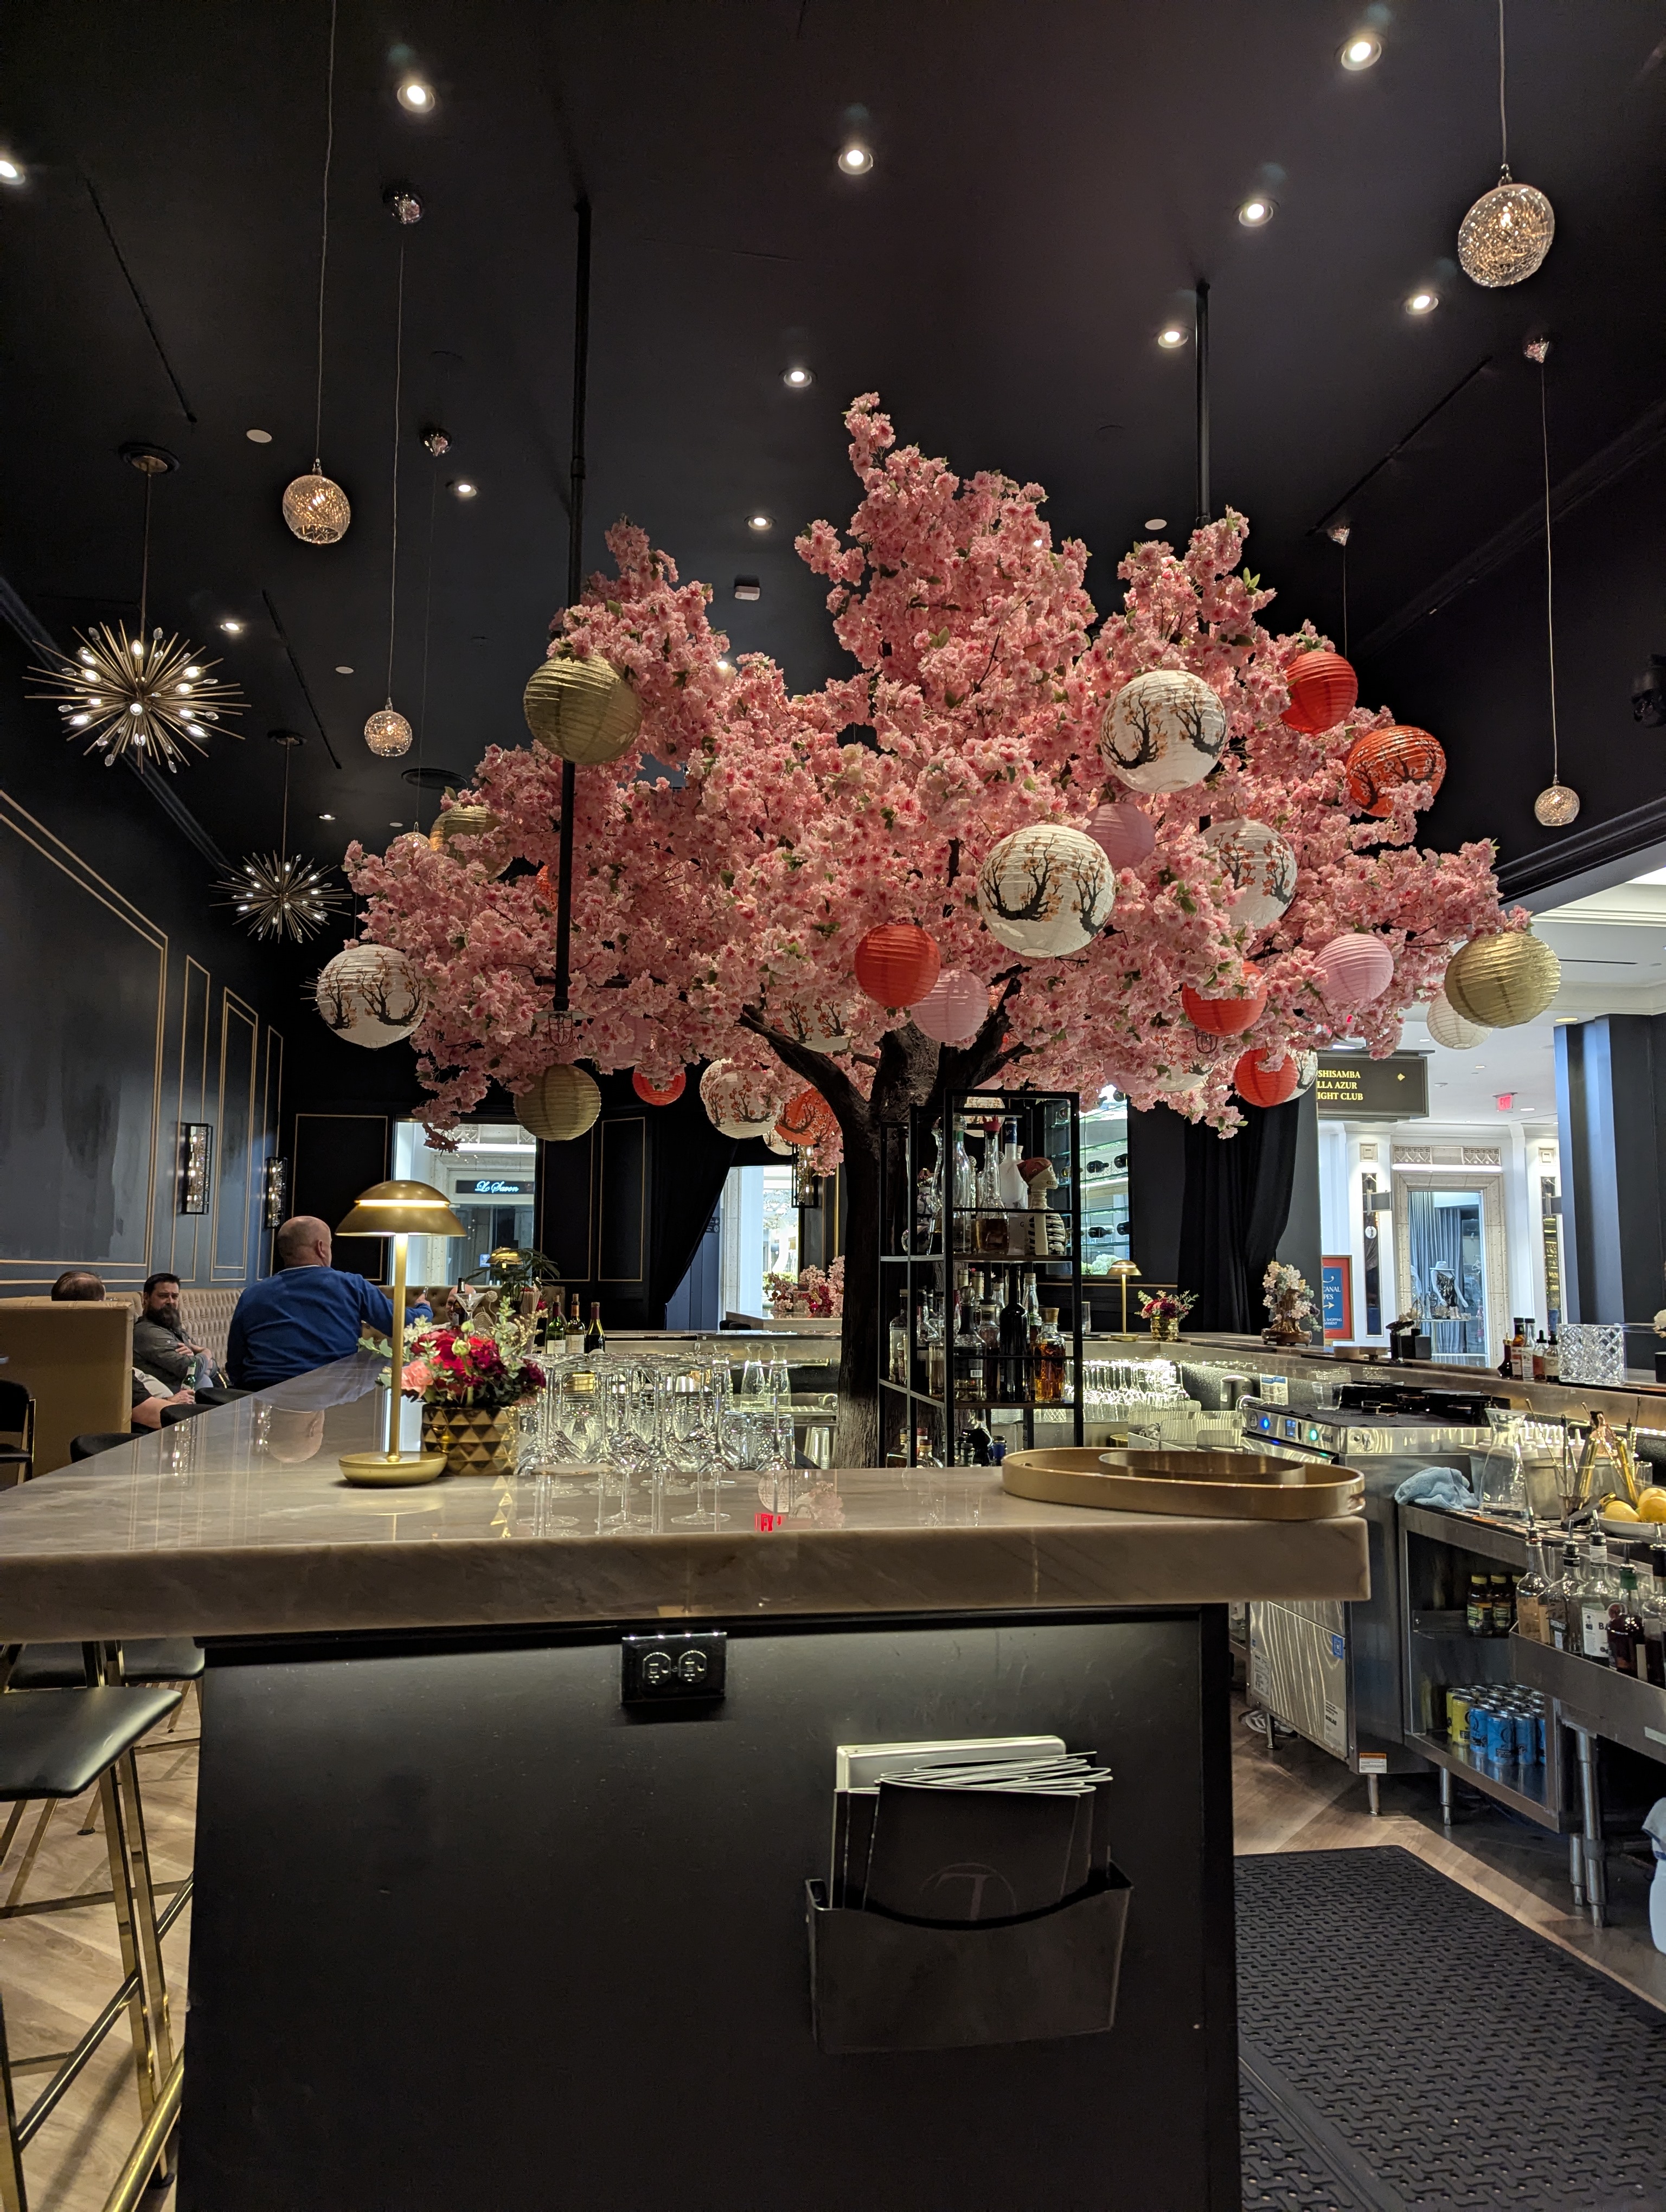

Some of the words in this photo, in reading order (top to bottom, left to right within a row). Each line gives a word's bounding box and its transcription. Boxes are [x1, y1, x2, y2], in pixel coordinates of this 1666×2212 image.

[1316, 1070, 1361, 1078] SHISAMBA
[1335, 1081, 1357, 1089] AZUR
[1341, 1092, 1363, 1101] CLUB
